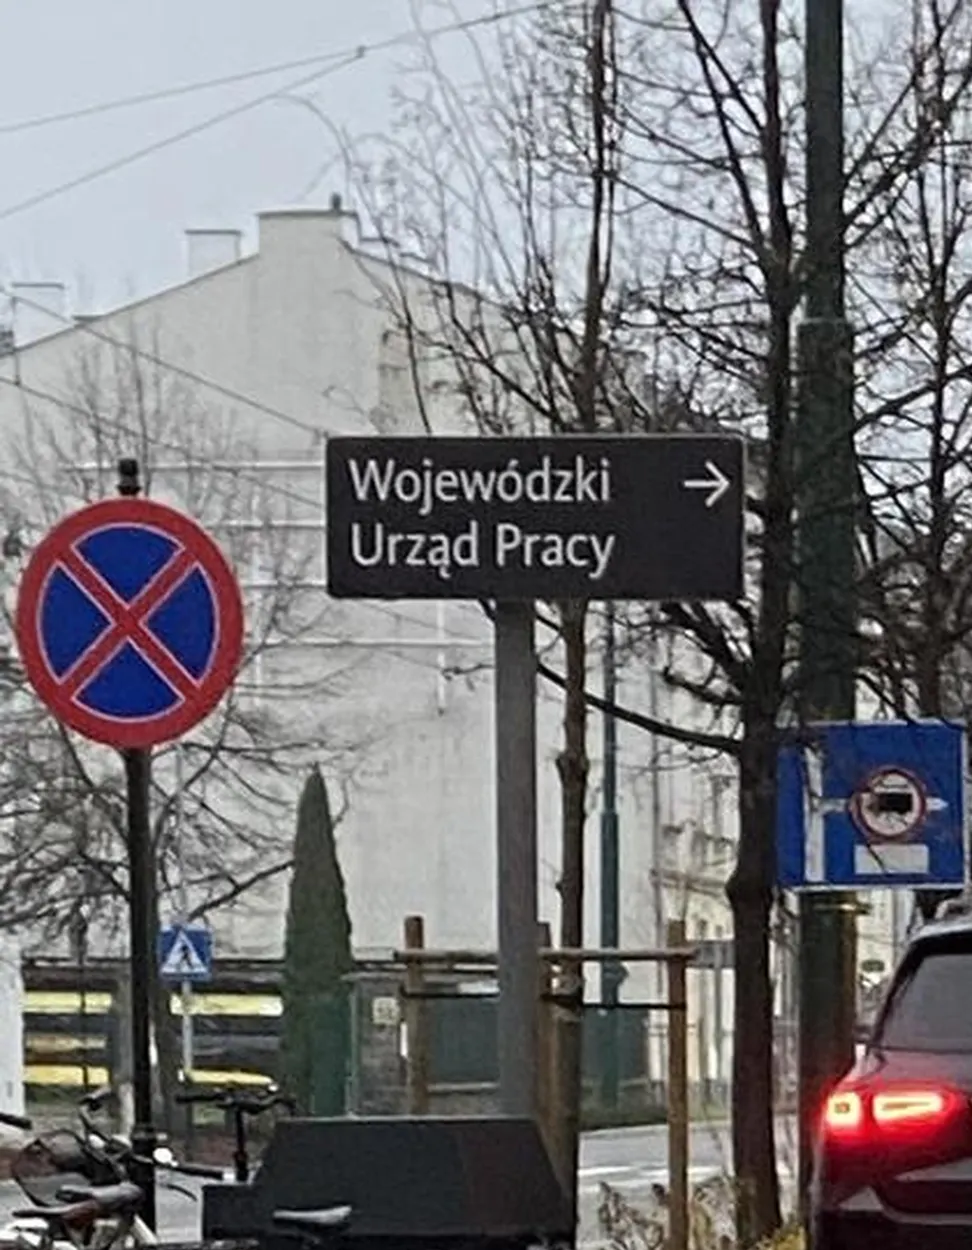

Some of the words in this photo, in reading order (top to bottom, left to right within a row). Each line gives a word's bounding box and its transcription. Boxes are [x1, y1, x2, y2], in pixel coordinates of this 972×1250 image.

[348, 456, 611, 515] Wojewódzki
[351, 521, 480, 579] Urząd
[495, 524, 616, 580] Pracy
